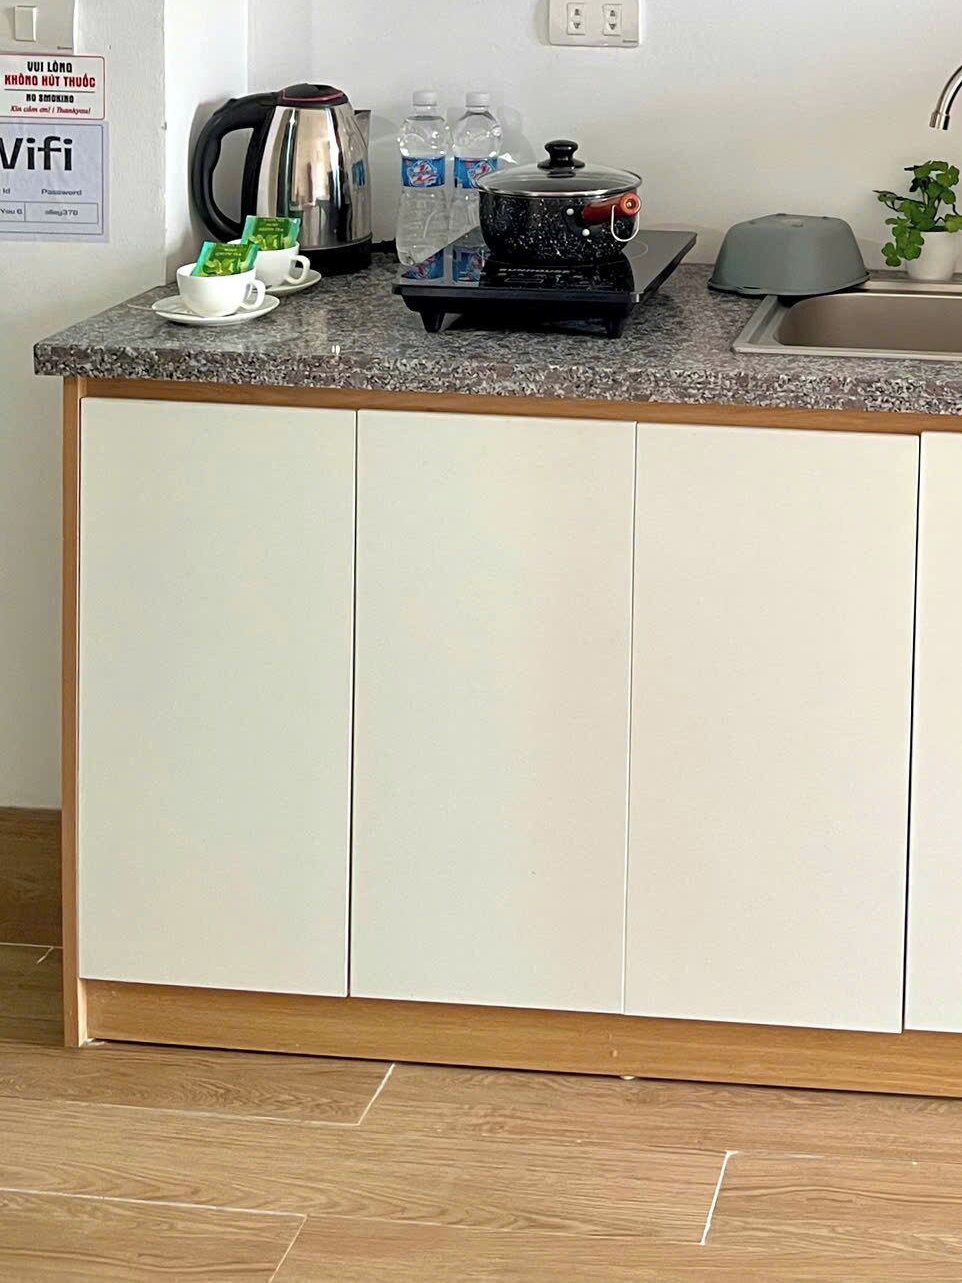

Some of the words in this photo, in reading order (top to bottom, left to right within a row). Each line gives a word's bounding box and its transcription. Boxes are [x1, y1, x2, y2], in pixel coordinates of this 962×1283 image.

[27, 61, 43, 72] VUI
[4, 73, 38, 86] KHÔNG
[41, 74, 60, 87] HÚT
[63, 73, 95, 88] THUỐC
[26, 94, 36, 102] NO
[38, 94, 74, 103] SMOKING
[10, 105, 22, 113] Xin
[41, 188, 82, 196] Password
